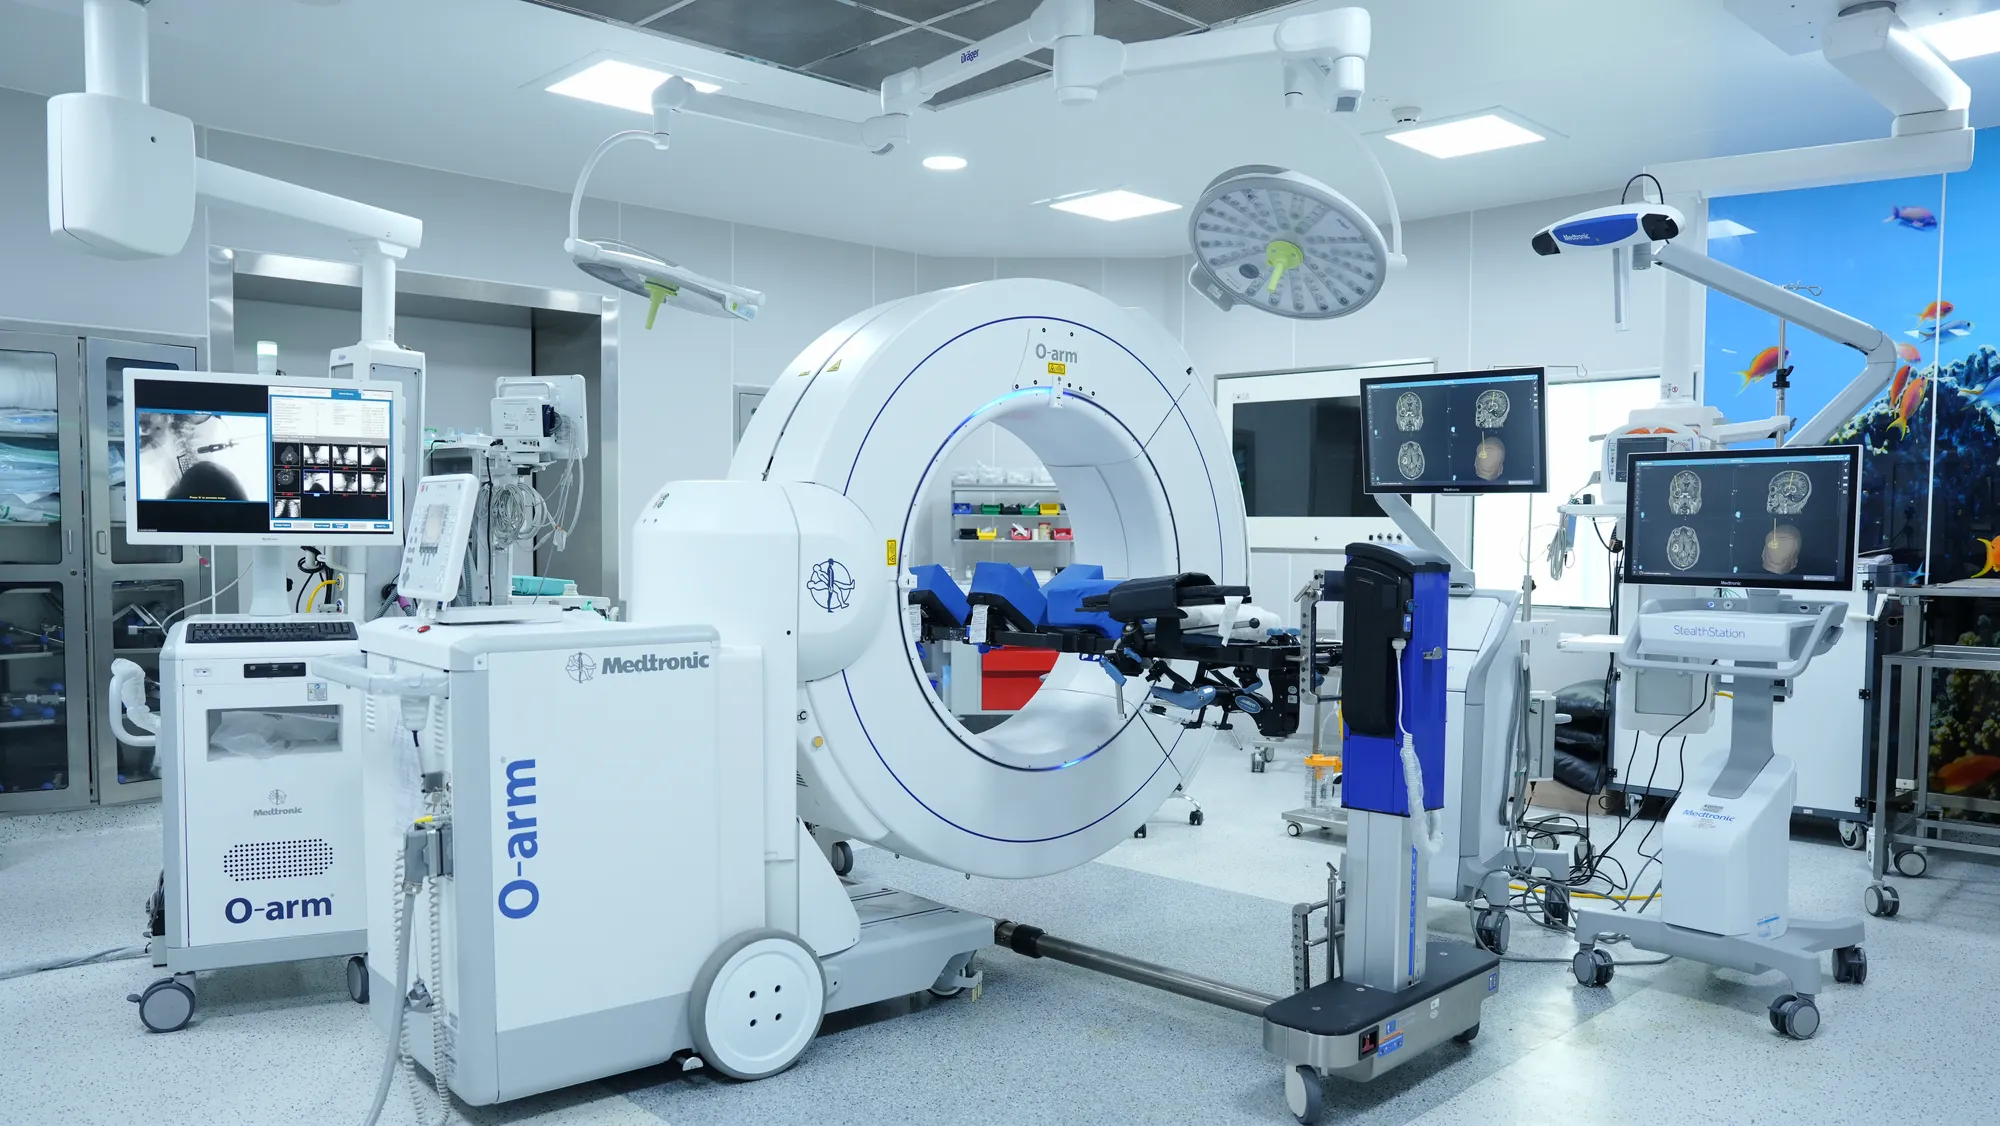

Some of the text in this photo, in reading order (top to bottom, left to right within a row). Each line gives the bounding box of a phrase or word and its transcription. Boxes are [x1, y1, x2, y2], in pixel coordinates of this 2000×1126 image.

[1563, 232, 1590, 241] Medtronic
[1036, 343, 1077, 363] O-arm
[1673, 624, 1746, 639] StealthStation
[601, 651, 710, 675] Medtronic
[253, 806, 303, 818] Medtronic
[1682, 809, 1736, 821] Medtronic
[498, 758, 540, 920] O-arm
[225, 897, 332, 924] O-arm
